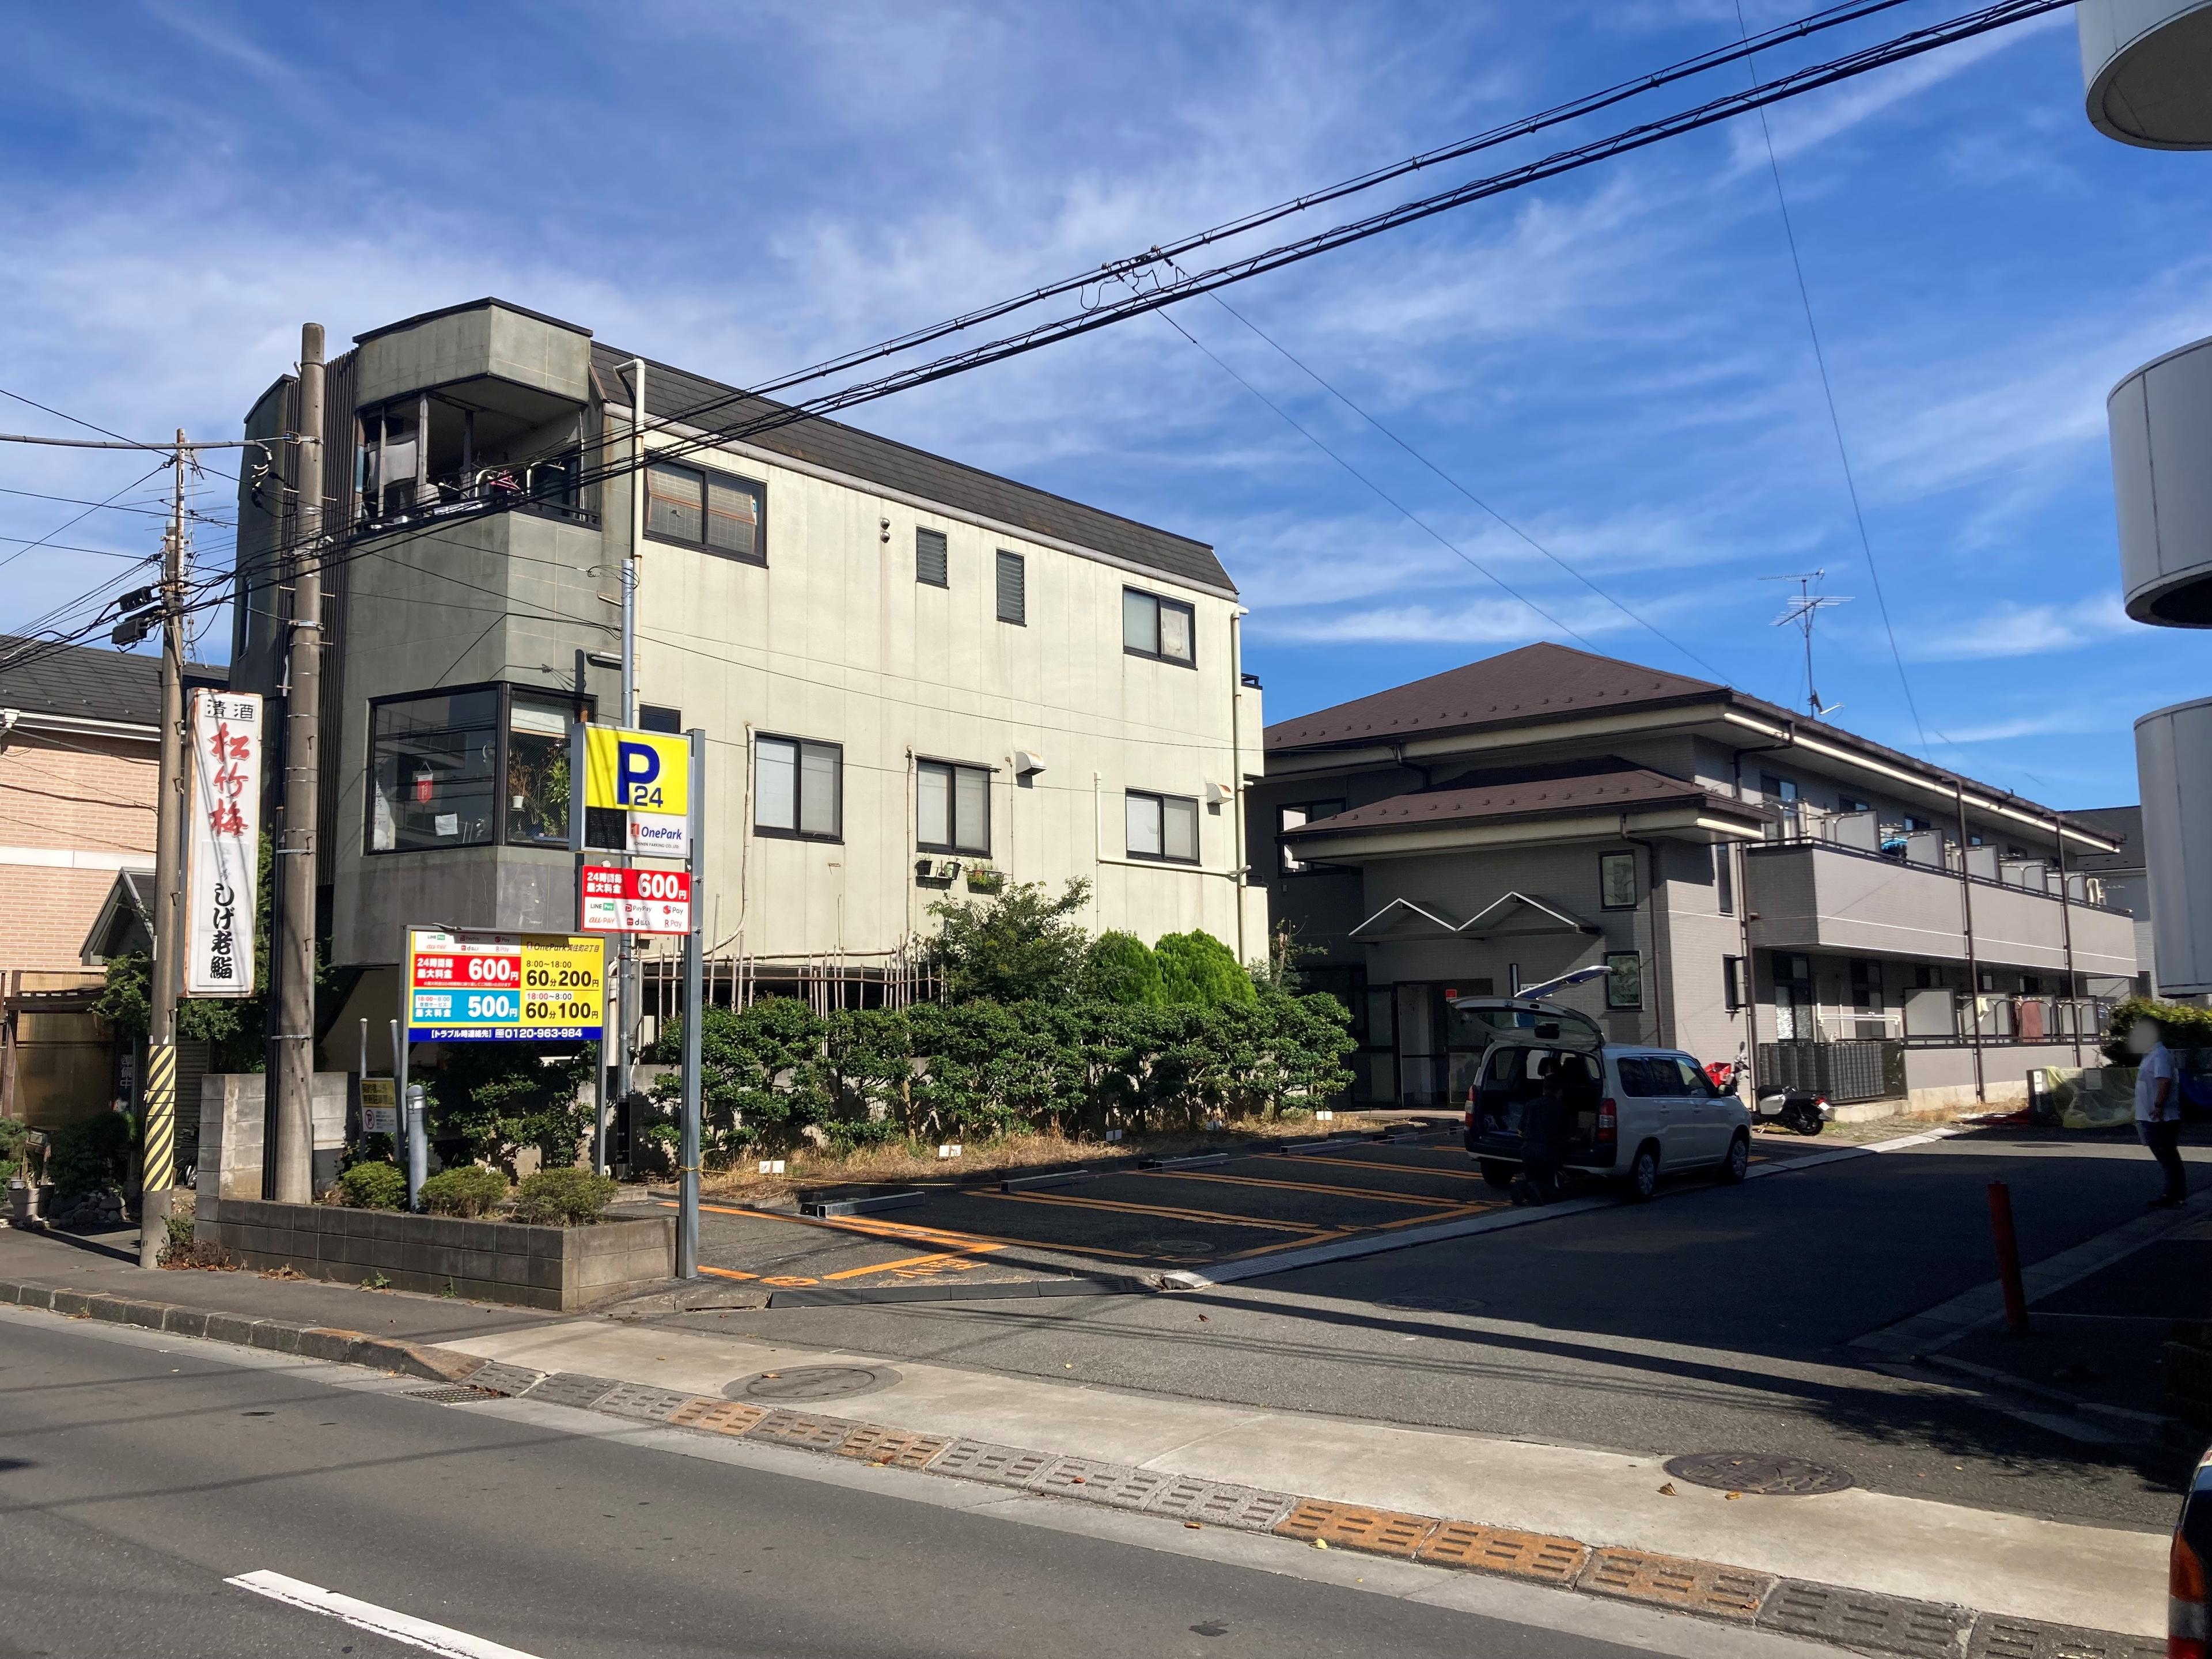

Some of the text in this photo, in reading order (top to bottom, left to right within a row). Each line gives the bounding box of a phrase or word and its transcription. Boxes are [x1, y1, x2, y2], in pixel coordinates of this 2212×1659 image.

[207, 699, 254, 719] 清酒
[210, 722, 250, 837] 松竹梅
[617, 741, 660, 805] P
[634, 785, 664, 808] 24
[642, 827, 682, 840] OnePark
[586, 882, 622, 894] 最大料金
[638, 873, 687, 900] 600円
[671, 920, 682, 928] Pay
[468, 958, 519, 981] 600円
[468, 995, 518, 1018] 500円
[505, 1028, 582, 1038] 0120-963-984
